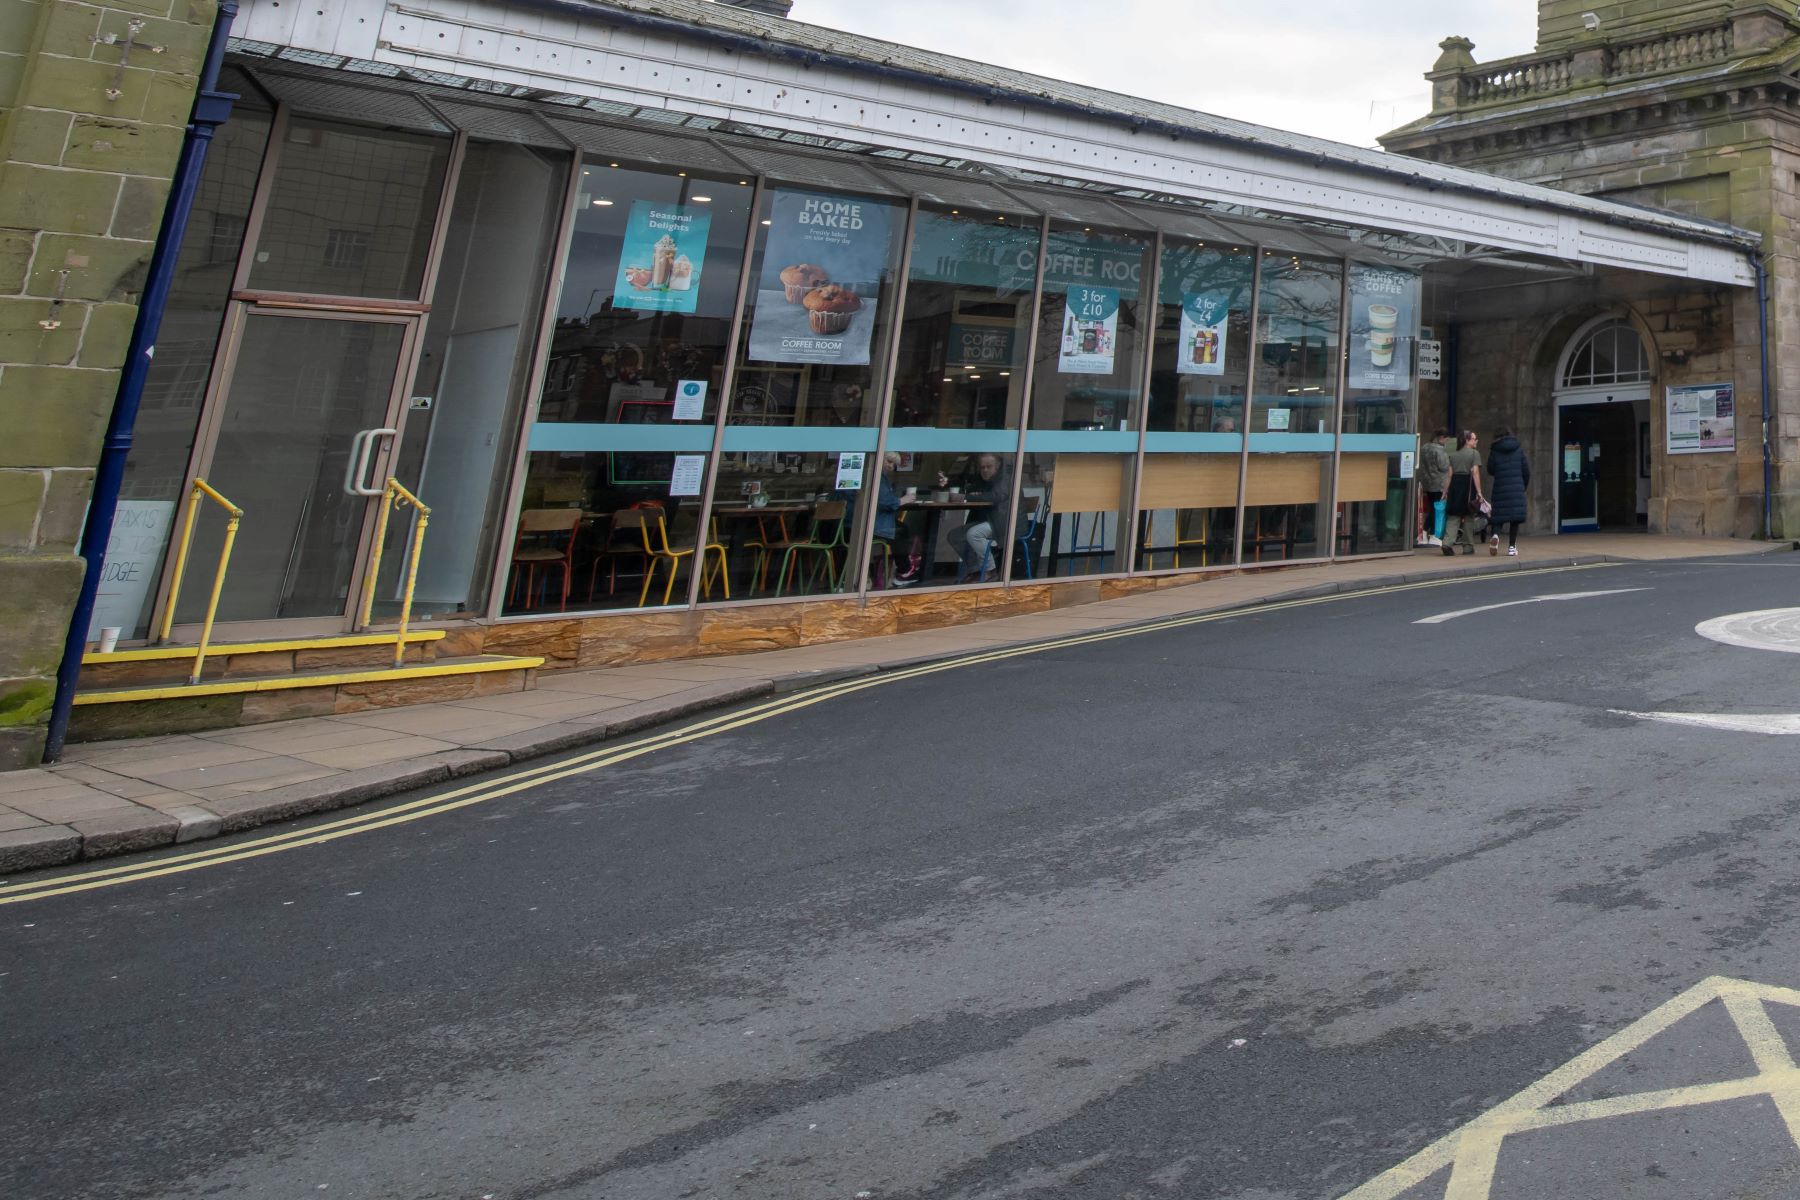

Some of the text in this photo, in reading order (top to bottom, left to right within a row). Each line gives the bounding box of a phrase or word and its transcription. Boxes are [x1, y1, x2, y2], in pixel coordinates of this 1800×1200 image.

[805, 199, 861, 217] HOME
[649, 210, 692, 222] Seasonal
[798, 211, 863, 230] BAKED
[649, 220, 689, 232] Delights
[1016, 249, 1095, 277] COFFEE
[1363, 271, 1405, 286] BARISTA
[1365, 282, 1402, 295] COFFEE
[1081, 289, 1106, 303] 3 for
[1082, 303, 1103, 316] £10
[1195, 297, 1217, 310] 2 for
[1199, 310, 1211, 322] £4
[782, 339, 842, 350] COFFEE ROOM
[962, 333, 1008, 348] COFFEE
[962, 345, 1004, 360] ROOM
[112, 509, 160, 529] TAXIS
